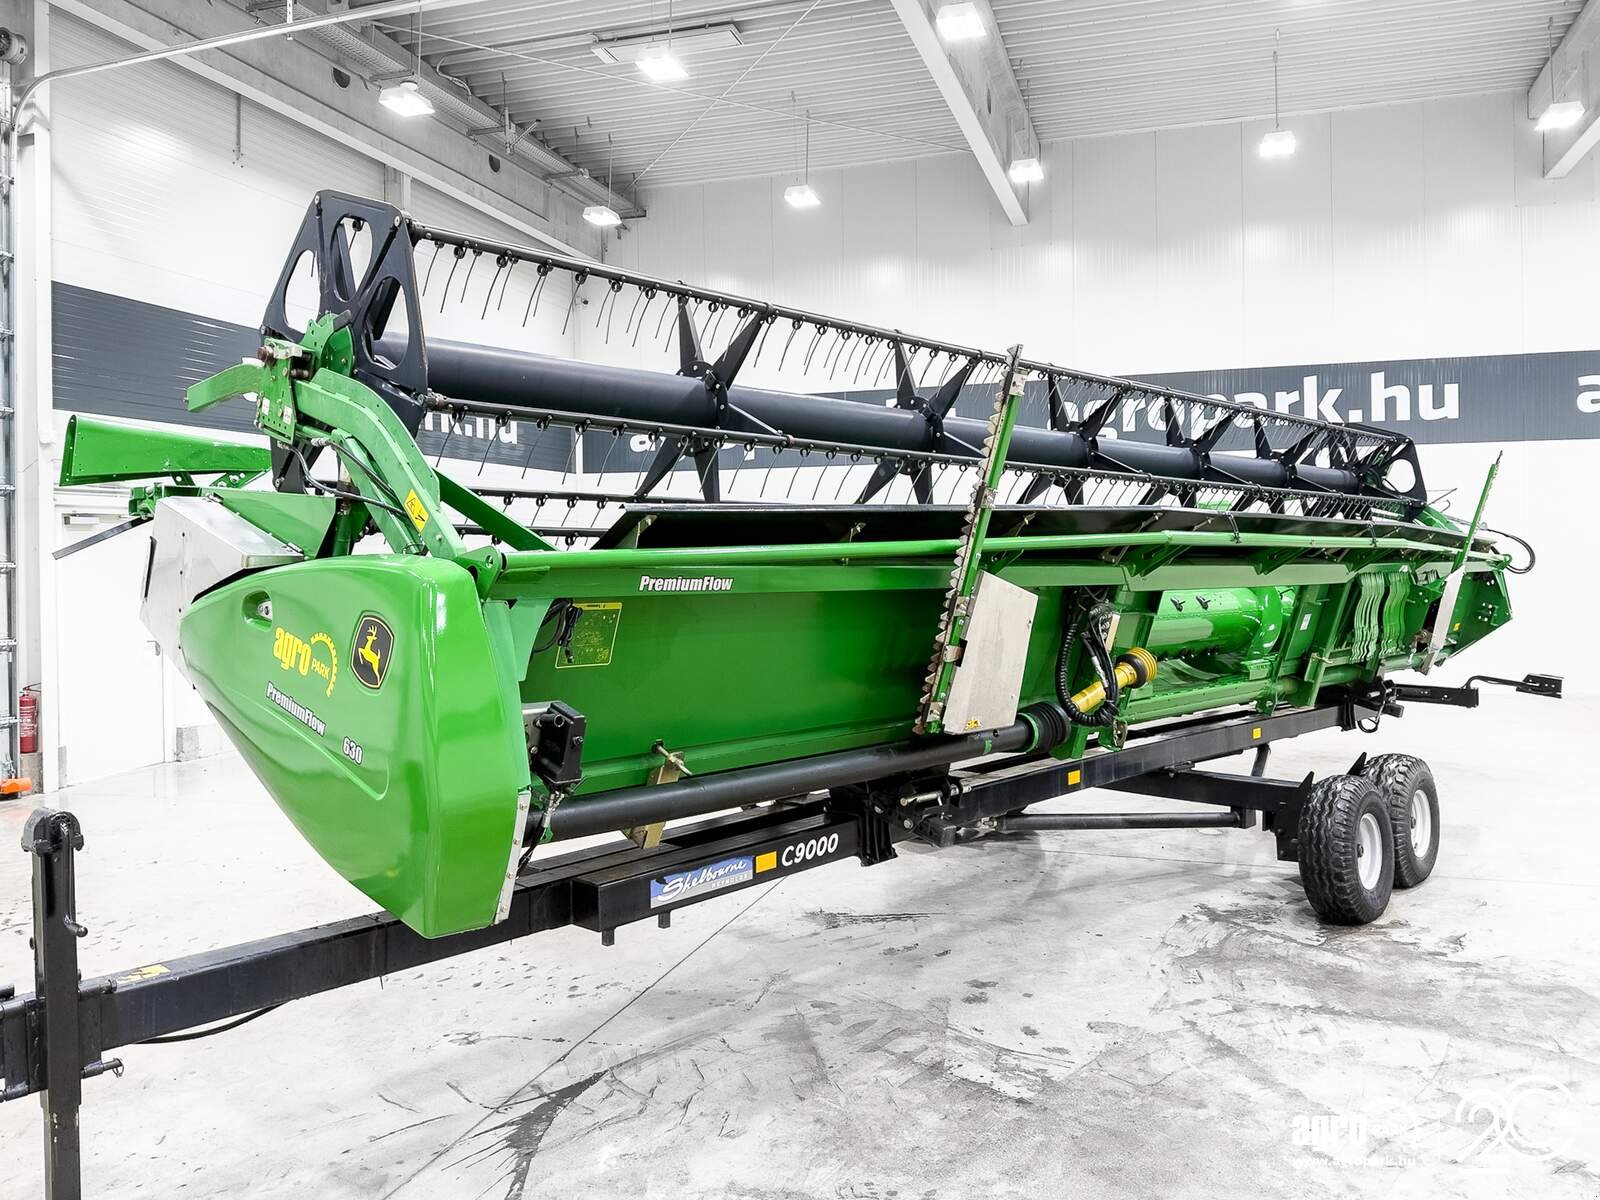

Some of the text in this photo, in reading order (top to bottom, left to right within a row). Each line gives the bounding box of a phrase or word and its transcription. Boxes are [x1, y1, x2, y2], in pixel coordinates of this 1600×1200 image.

[639, 575, 733, 592] PremiumFlow
[273, 627, 331, 680] agro PARK
[266, 681, 327, 737] PremiumFlow
[342, 735, 363, 765] 630
[781, 832, 839, 868] C9000
[656, 860, 748, 902] Shelbourne
